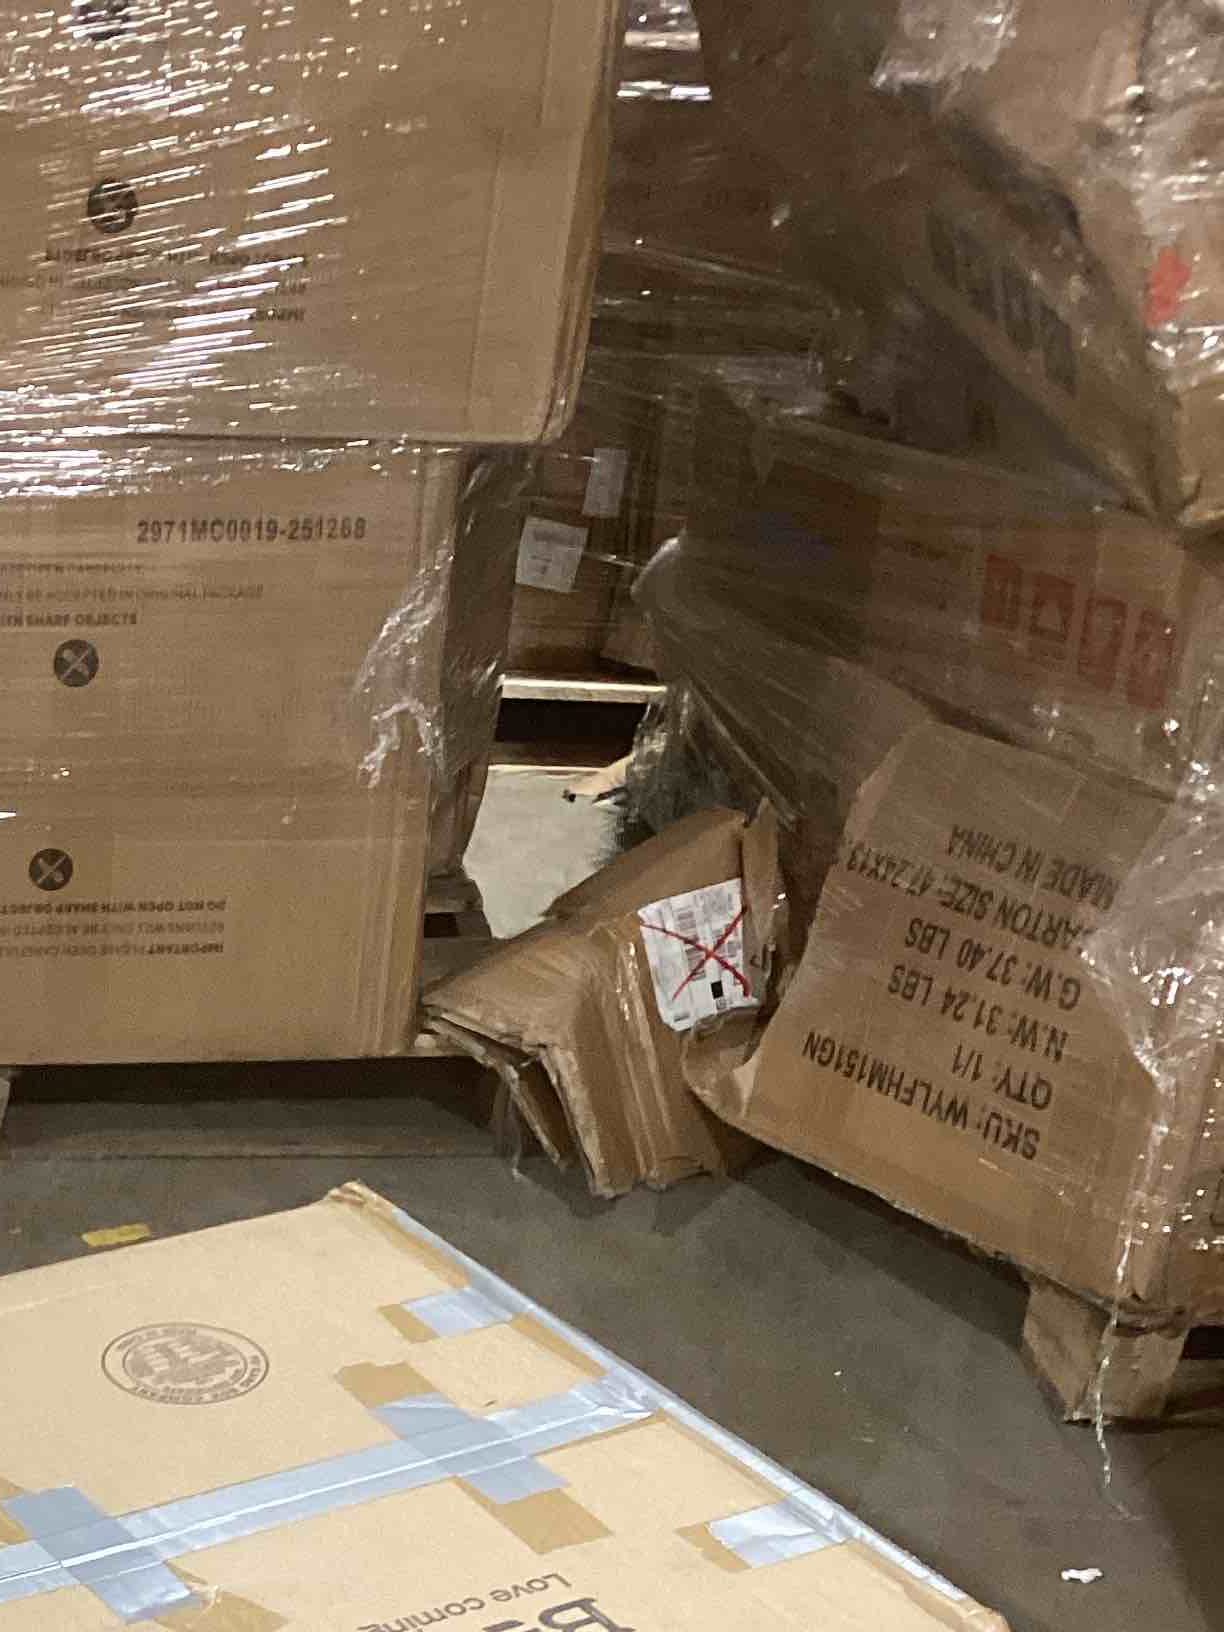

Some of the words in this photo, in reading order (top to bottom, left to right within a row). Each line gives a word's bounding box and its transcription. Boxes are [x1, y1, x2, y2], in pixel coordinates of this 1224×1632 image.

[949, 826, 1018, 874] CHINA
[904, 917, 951, 960] LBS
[956, 938, 1018, 985] 37.40
[888, 964, 934, 1007] LBS
[941, 986, 1004, 1036] 31.24
[952, 1044, 984, 1083] 1/1
[976, 1106, 1041, 1161] SKU:
[489, 1572, 574, 1604] Love
